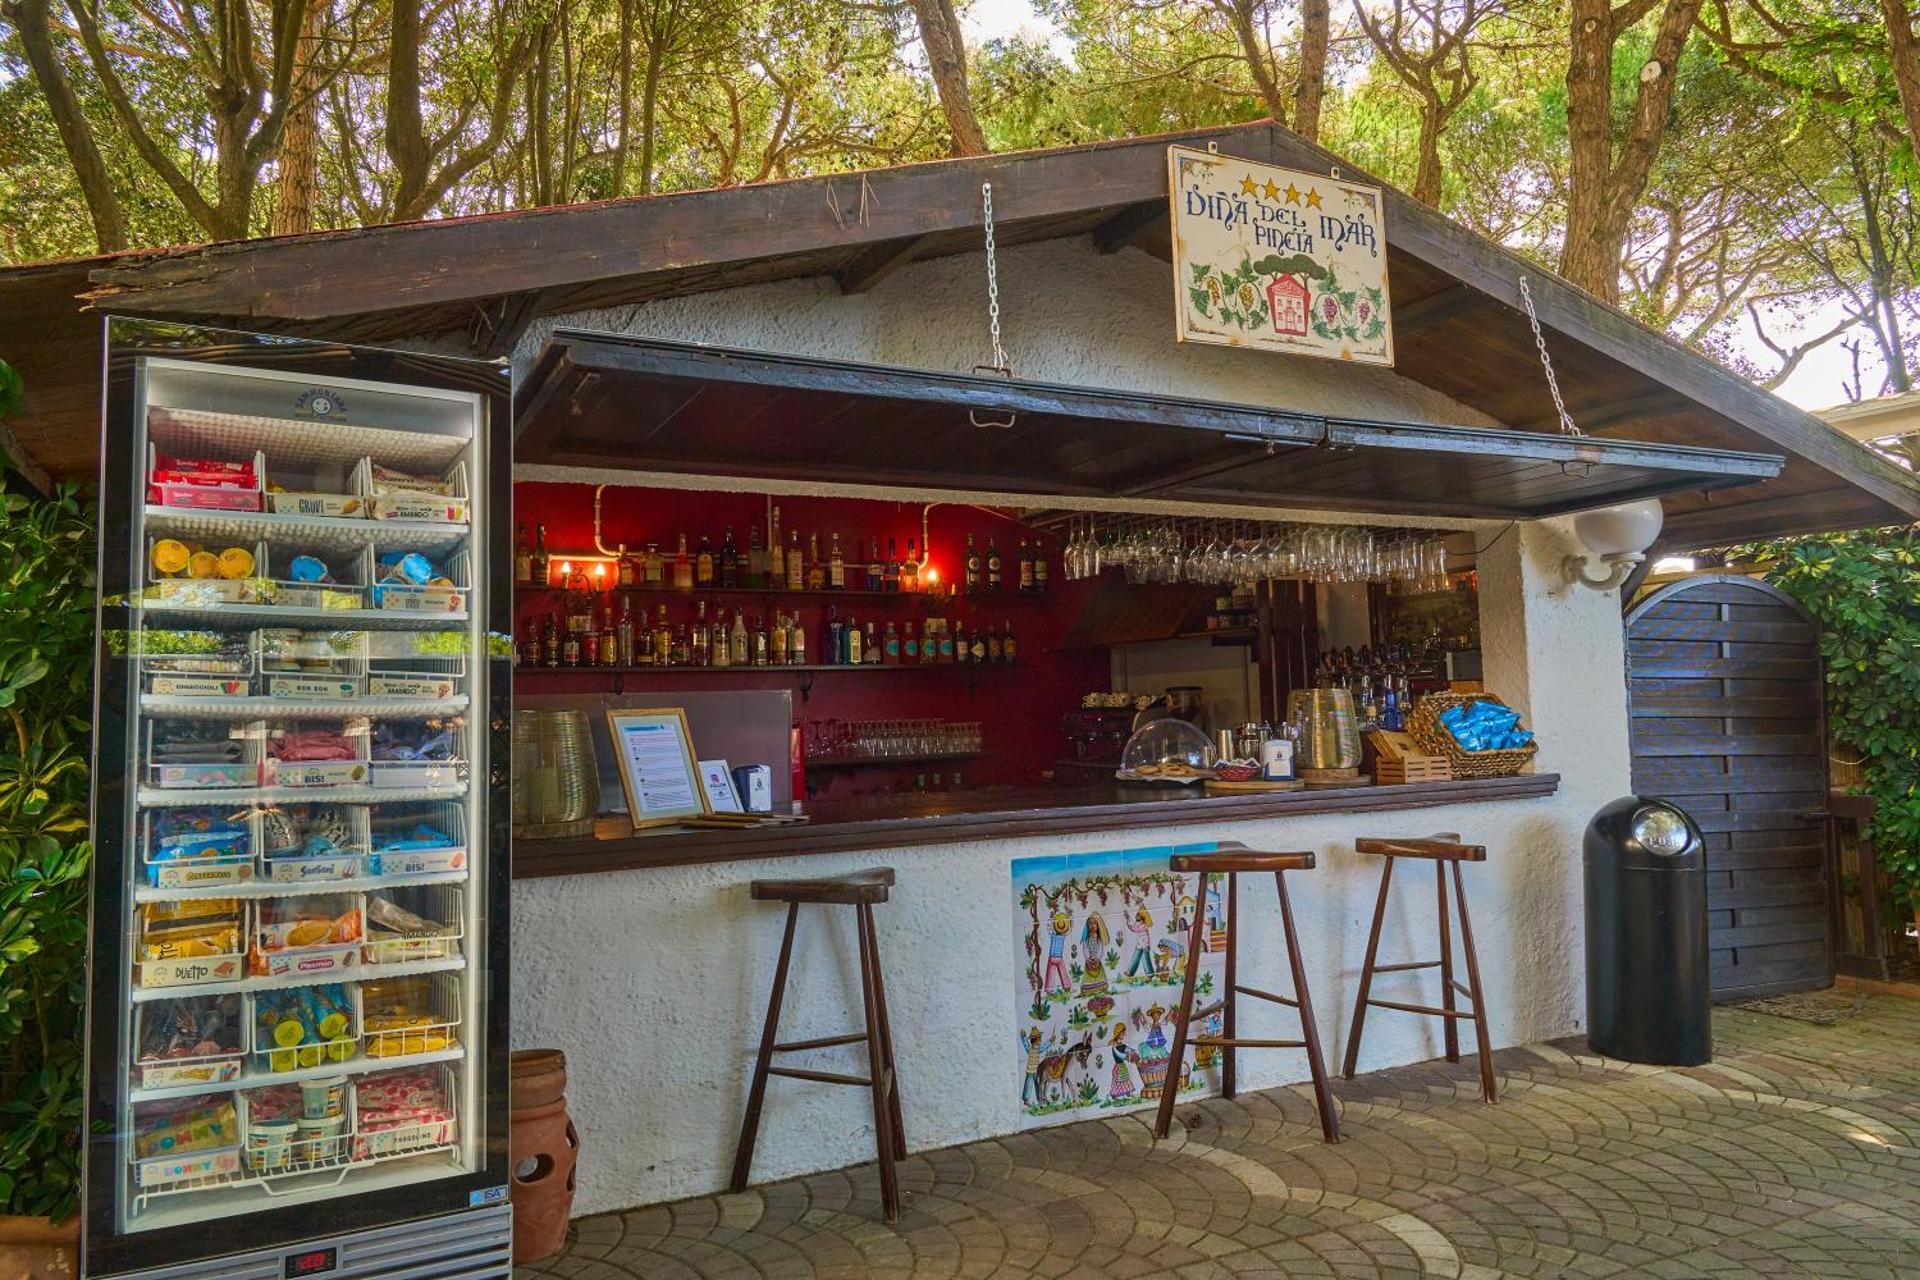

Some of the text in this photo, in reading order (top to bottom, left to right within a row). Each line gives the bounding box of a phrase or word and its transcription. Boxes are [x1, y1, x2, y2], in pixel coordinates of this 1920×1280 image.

[1252, 217, 1315, 256] PINETA
[1255, 200, 1307, 227] DEL
[1319, 213, 1378, 258] MAR
[175, 965, 208, 981] DUETTO
